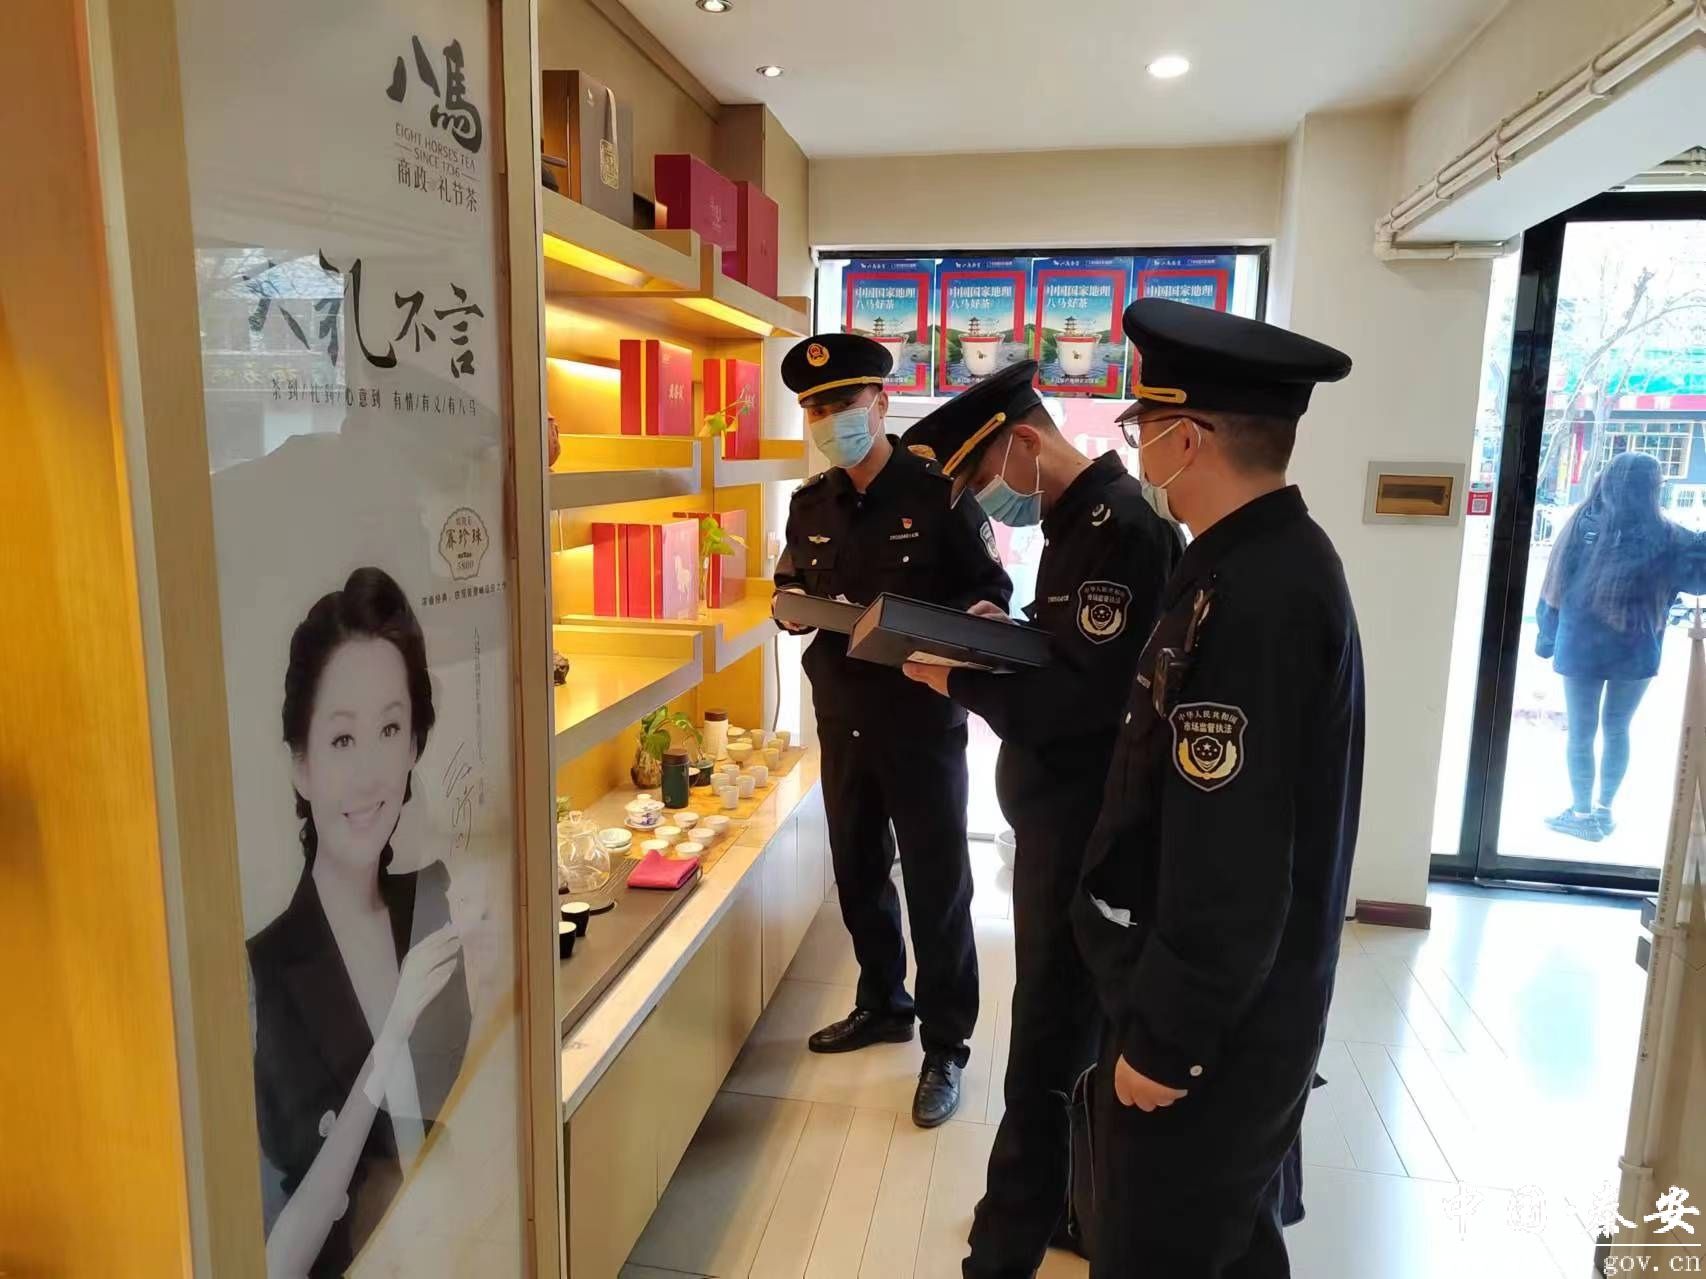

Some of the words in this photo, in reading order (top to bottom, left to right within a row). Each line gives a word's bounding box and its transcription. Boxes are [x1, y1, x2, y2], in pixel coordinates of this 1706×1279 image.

[395, 122, 421, 145] EIGHT
[460, 154, 476, 172] TEA
[414, 147, 440, 168] SINCE
[855, 286, 915, 298] 中国国家地理
[949, 285, 1011, 298] 中国国家地理
[1046, 284, 1110, 297] 中国国家地理
[1147, 284, 1213, 297] 中国国家地理
[856, 299, 894, 310] 八马好茶
[951, 299, 991, 310] 八马好茶
[1046, 297, 1088, 309] 八马好茶
[1178, 710, 1239, 725] 中华人民共和国
[1183, 722, 1233, 734] 市场监督执法
